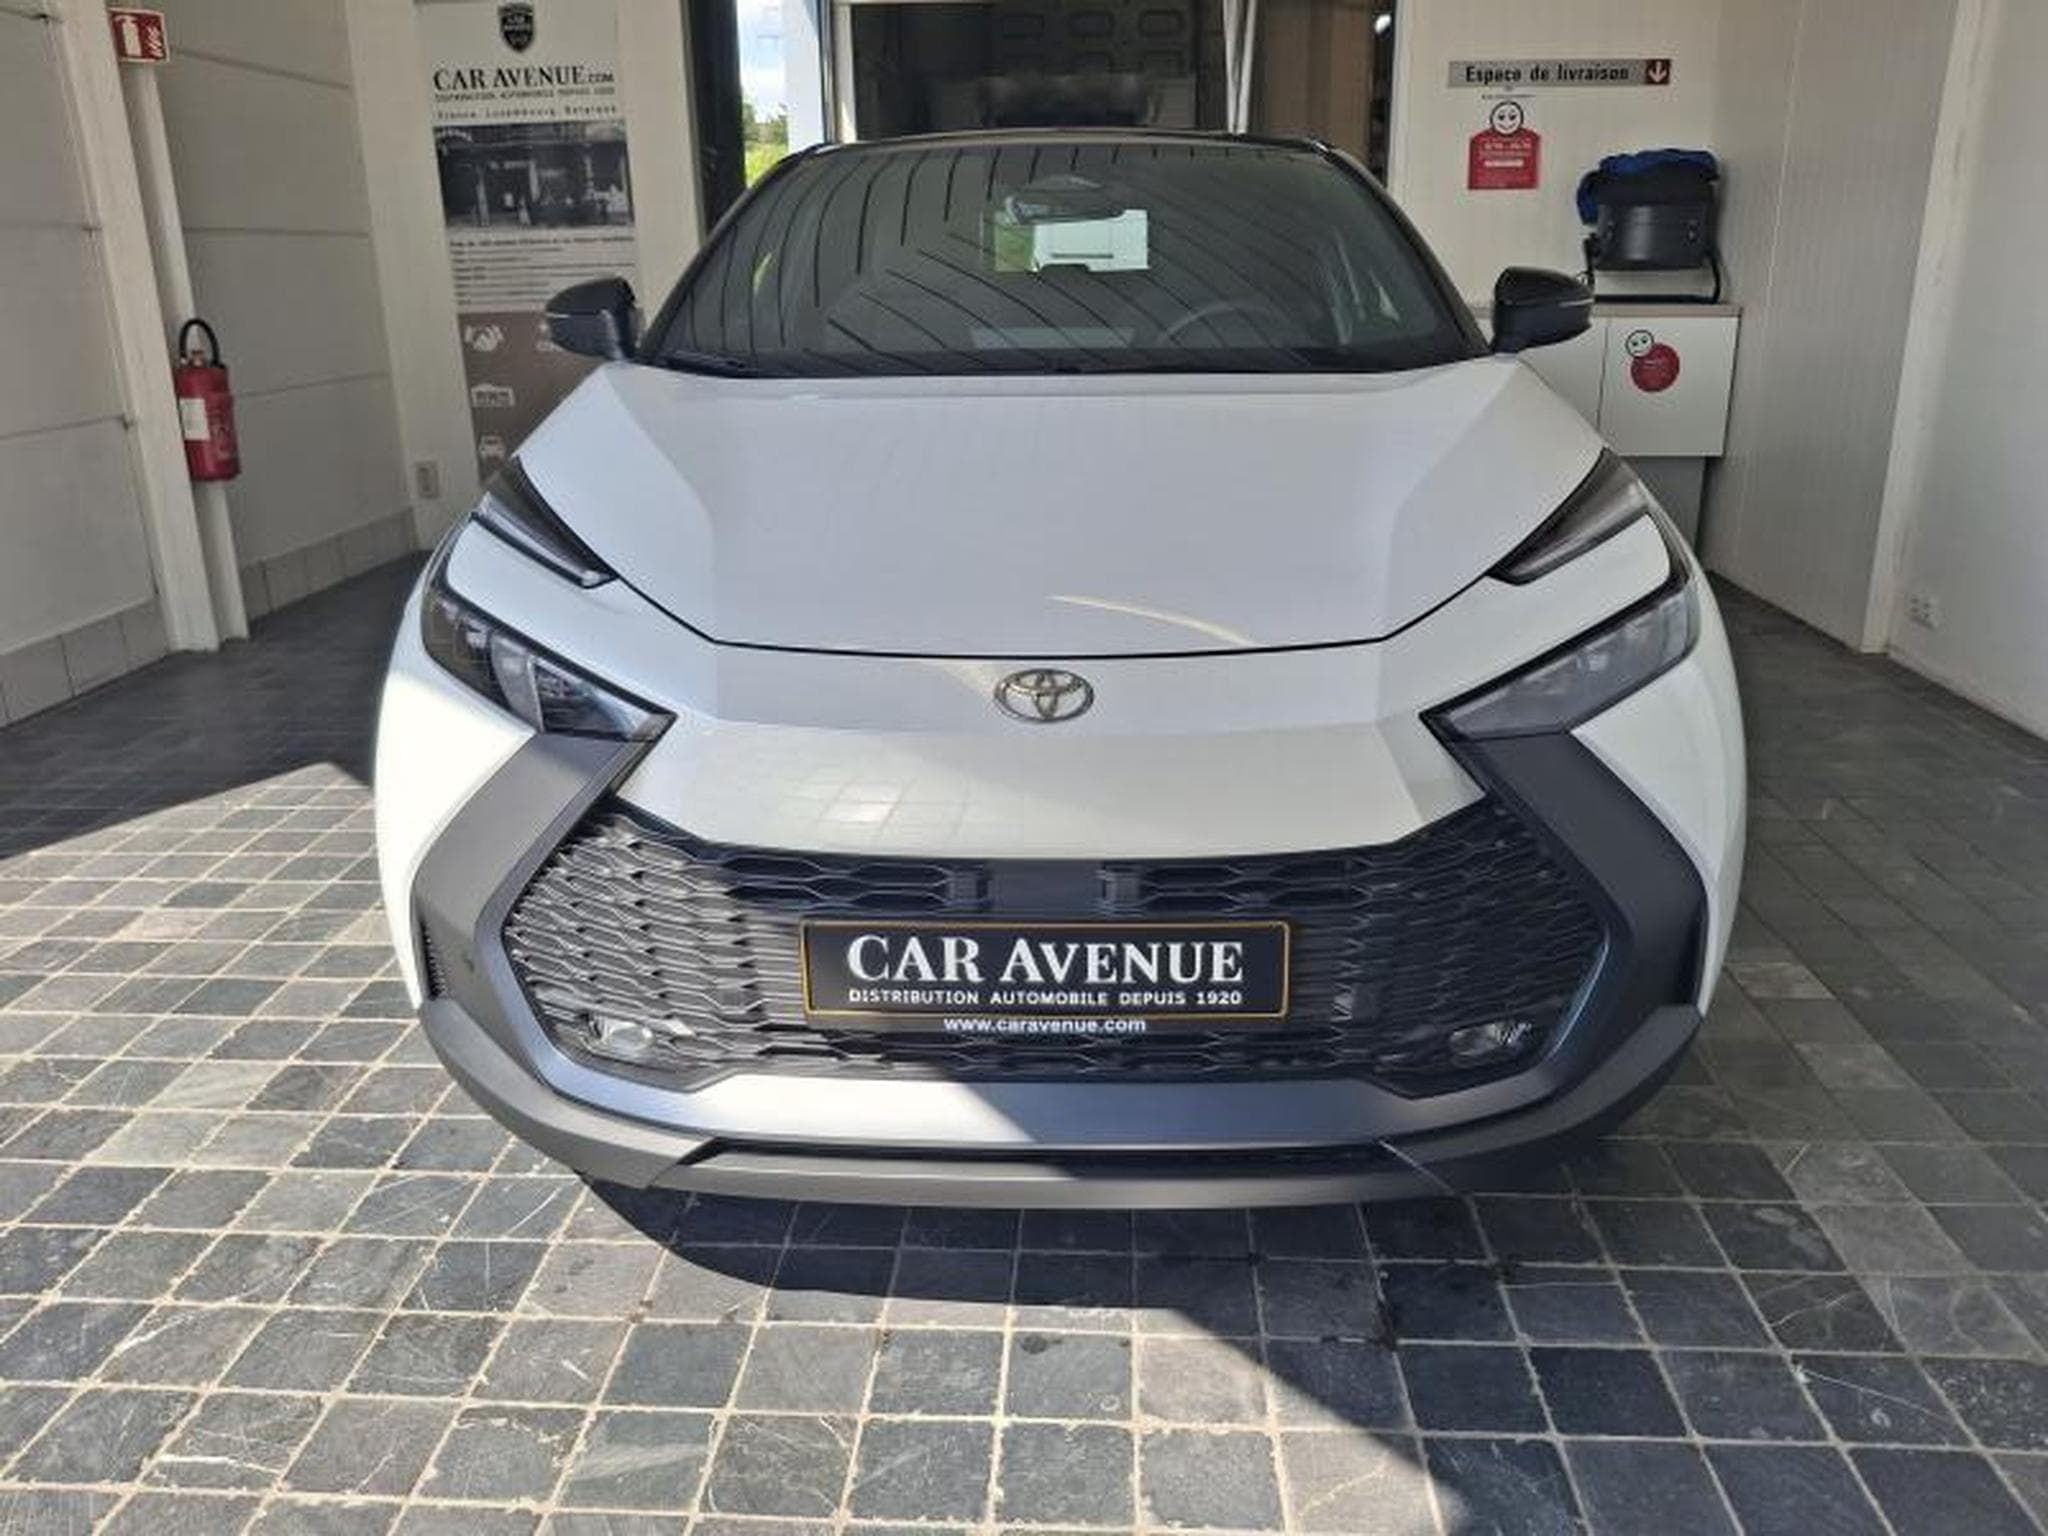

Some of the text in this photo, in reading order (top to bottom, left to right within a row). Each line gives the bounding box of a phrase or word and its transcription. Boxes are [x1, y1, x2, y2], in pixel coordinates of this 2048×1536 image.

[432, 68, 486, 91] CAR
[1465, 63, 1629, 85] Espace de livraison
[847, 934, 1244, 984] CAR AVENUE
[849, 988, 1242, 1006] DISTRIBUTION AUTOMOBILE DEPUIS 1920
[943, 1018, 1147, 1034] www.caravenue.com
